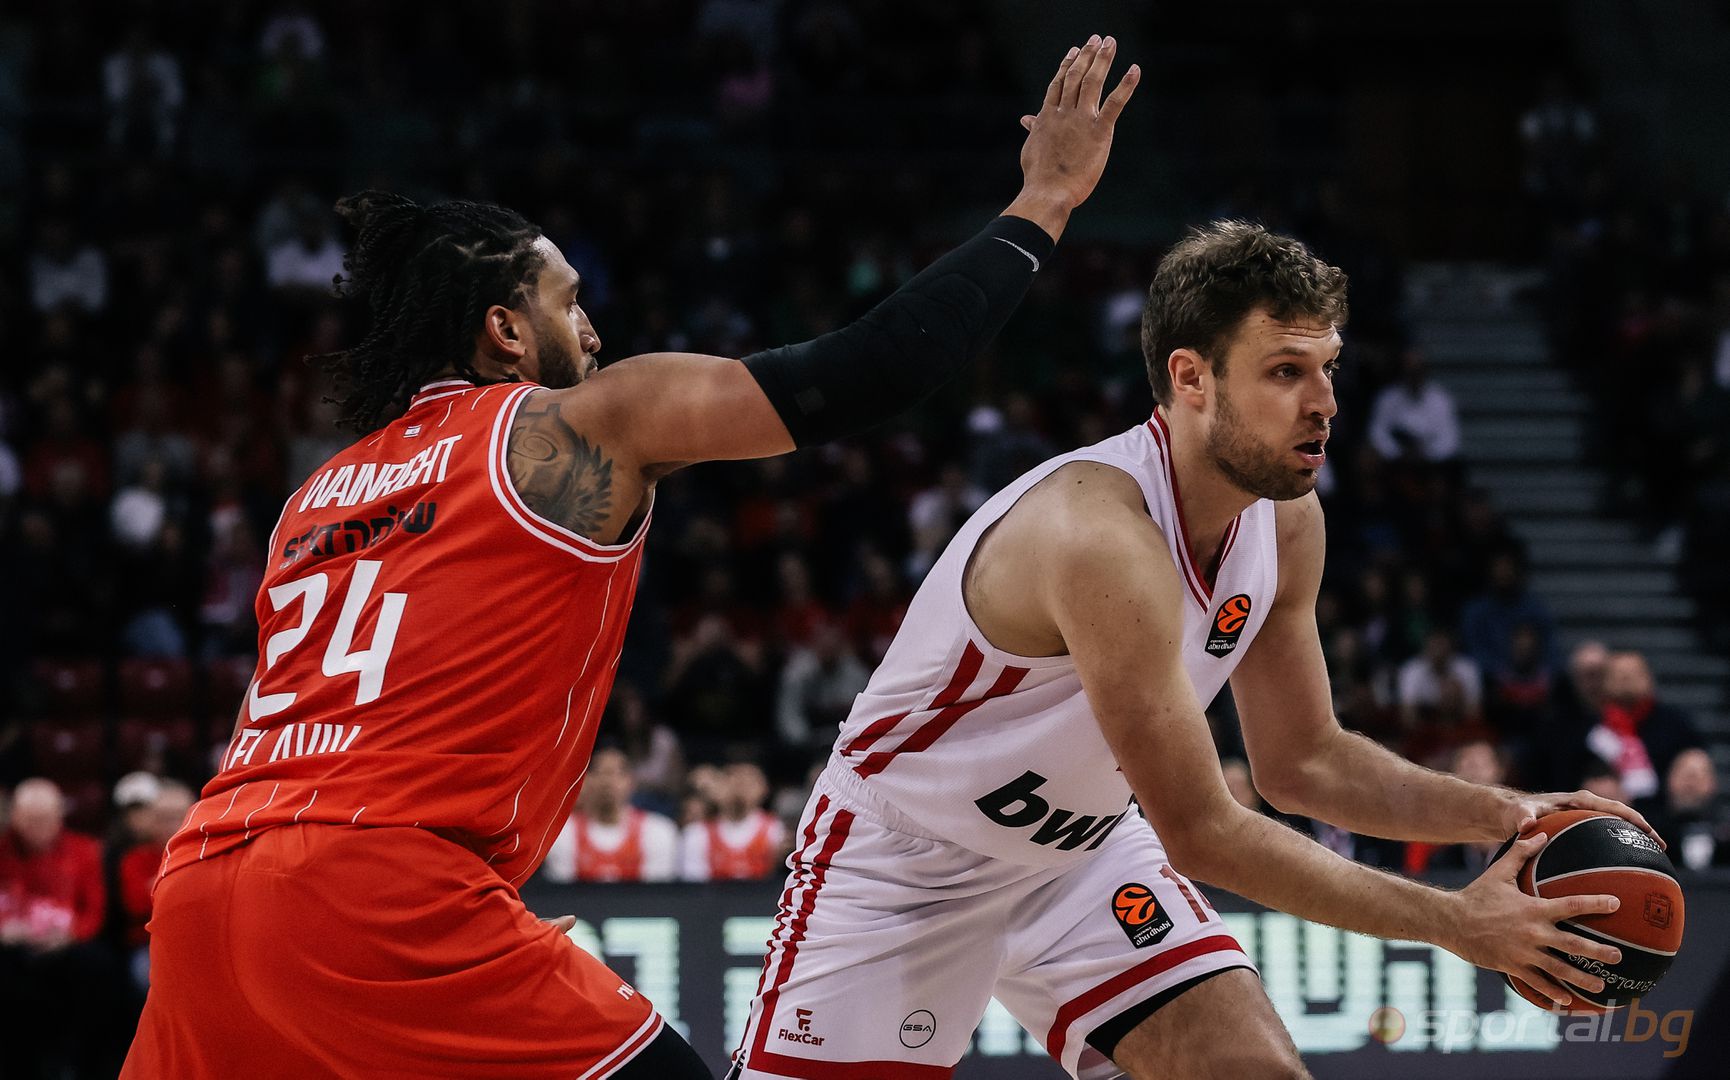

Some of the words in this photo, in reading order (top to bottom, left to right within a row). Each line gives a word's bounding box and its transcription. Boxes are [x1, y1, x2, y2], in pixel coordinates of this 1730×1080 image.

[248, 559, 408, 723] 24
[1158, 863, 1214, 924] 1
[778, 1028, 825, 1046] FlexCar
[902, 1024, 932, 1033] GSA
